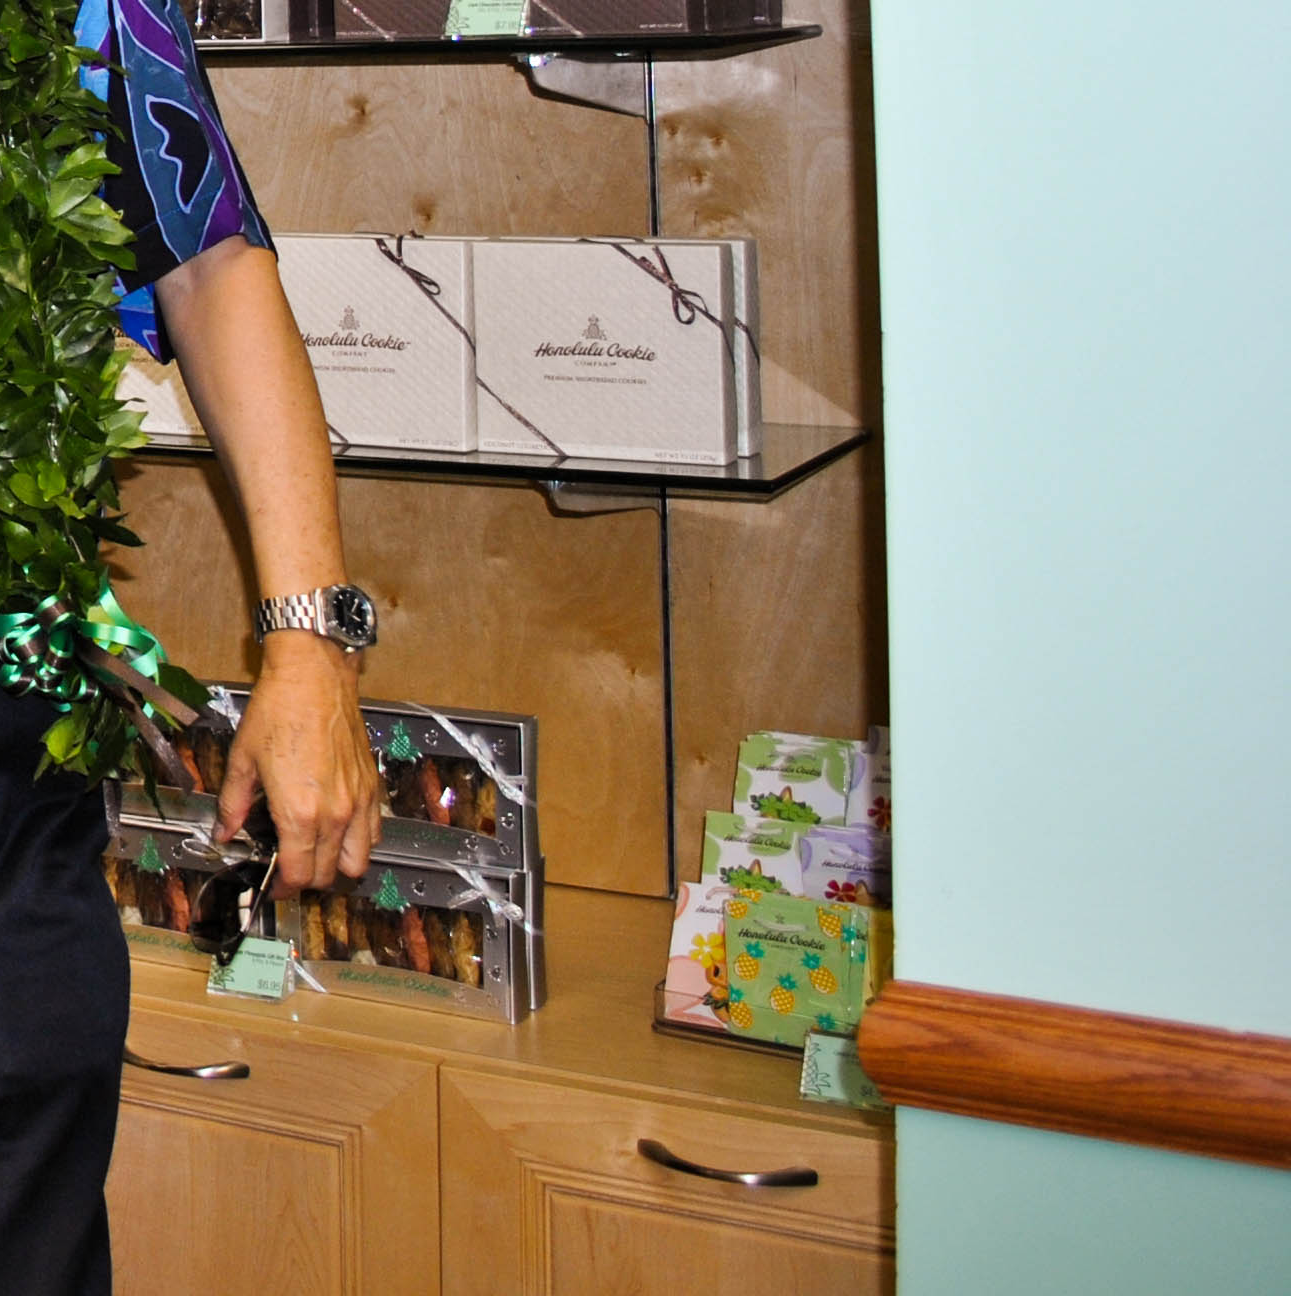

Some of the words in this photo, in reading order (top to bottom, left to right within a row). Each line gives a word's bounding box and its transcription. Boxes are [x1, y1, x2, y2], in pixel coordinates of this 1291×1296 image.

[360, 331, 407, 352] Cookie
[533, 341, 604, 358] Honolulu
[606, 342, 657, 362] Cookie
[738, 928, 789, 944] Honolulu
[790, 934, 826, 951] Cookie
